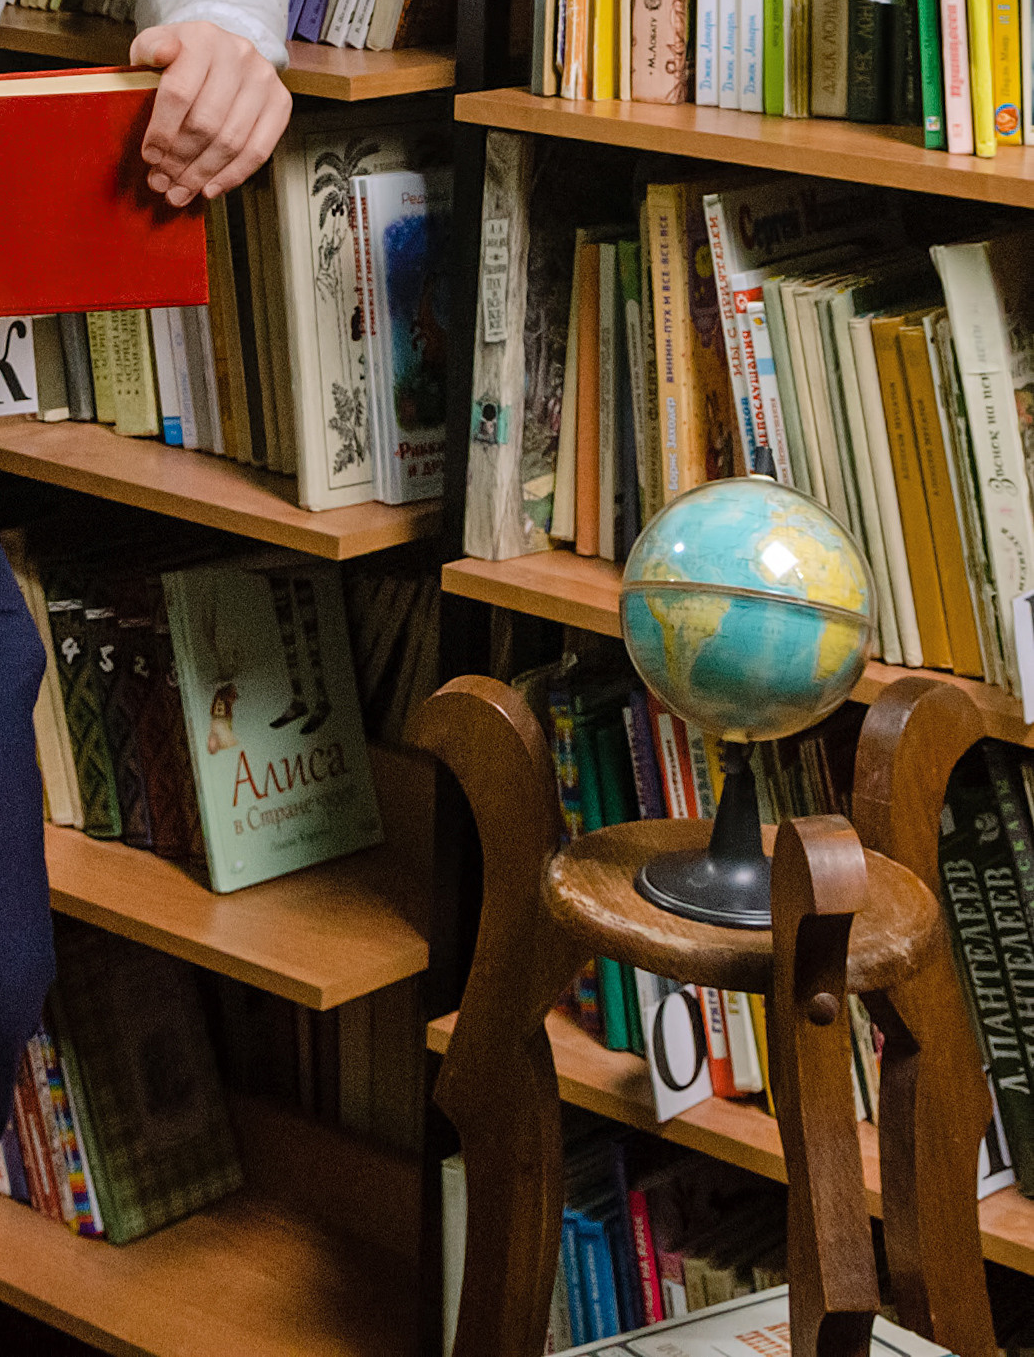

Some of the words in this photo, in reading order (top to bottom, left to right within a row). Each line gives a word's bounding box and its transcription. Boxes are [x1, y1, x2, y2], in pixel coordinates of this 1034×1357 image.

[661, 309, 675, 383] ВИННИ-ПУХ
[727, 327, 737, 339] С
[730, 346, 743, 376] МЫ
[984, 405, 998, 426] на
[232, 742, 349, 807] Алиса
[234, 818, 245, 835] в
[946, 855, 1019, 1061] ПАНТЕЛЕЕВ
[652, 989, 706, 1093] О
